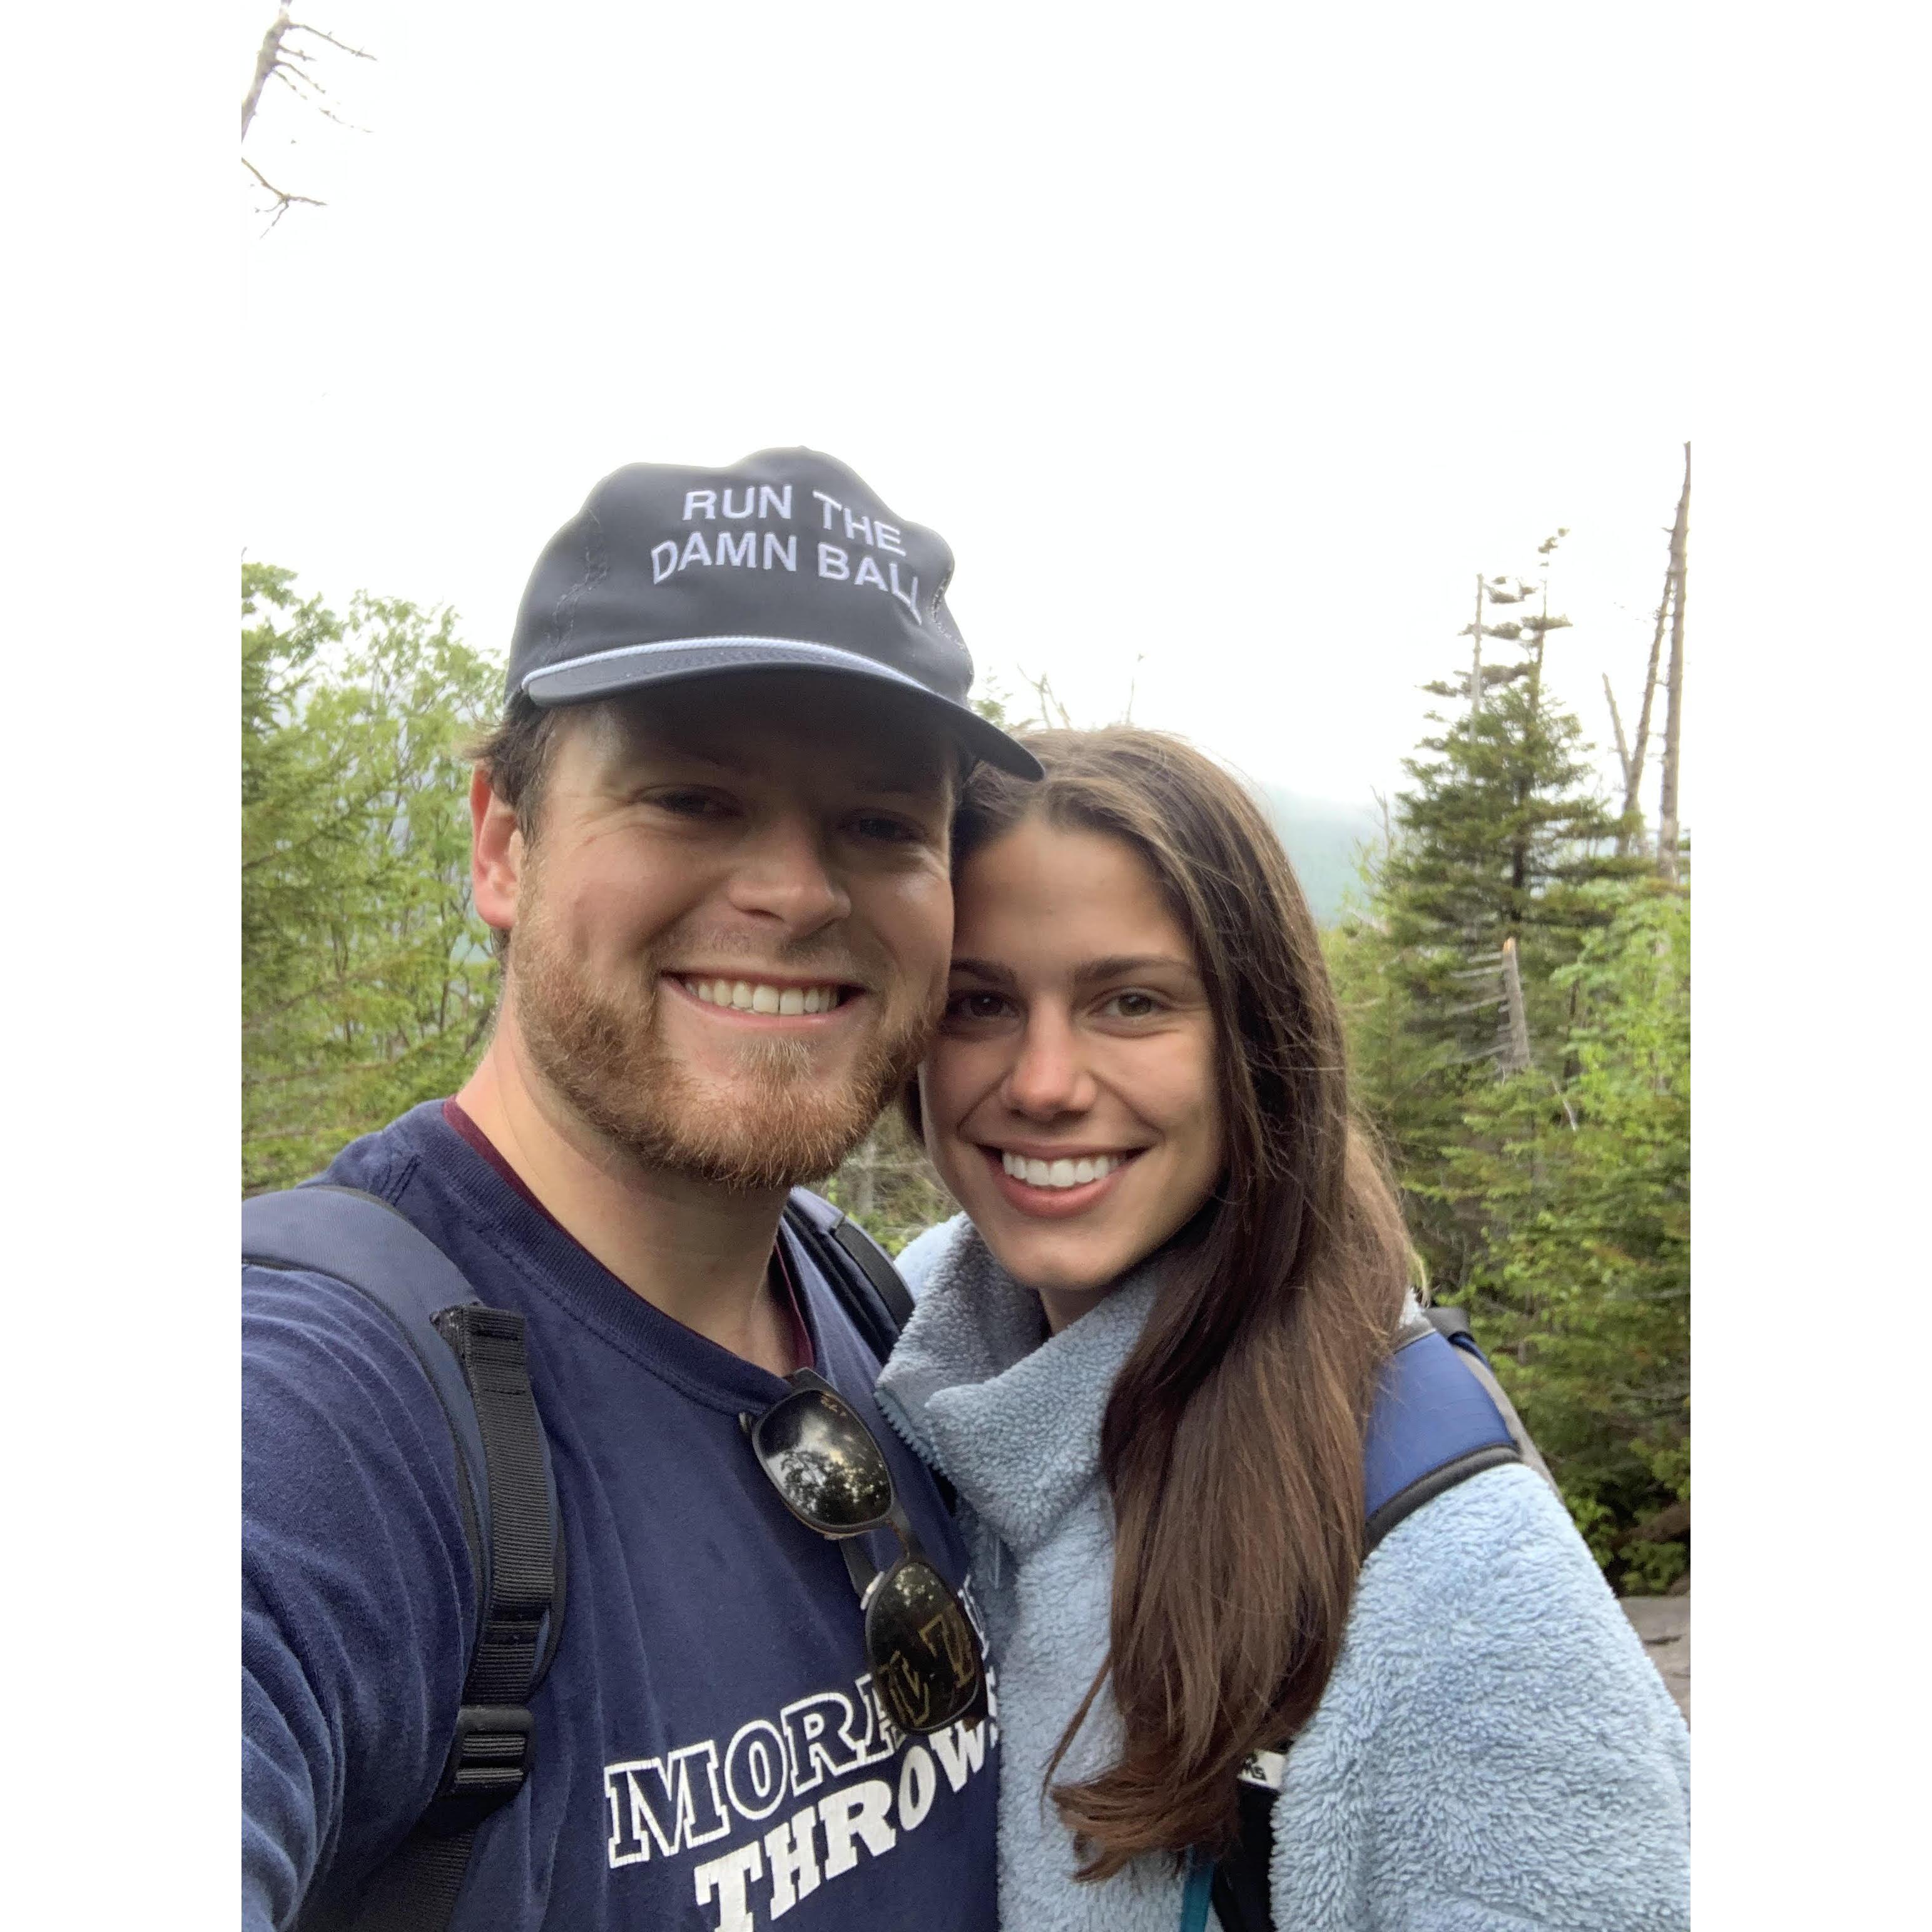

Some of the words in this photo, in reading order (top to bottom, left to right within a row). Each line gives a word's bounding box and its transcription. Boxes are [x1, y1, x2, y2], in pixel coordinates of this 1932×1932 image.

[682, 484, 793, 521] RUN
[813, 490, 907, 556] THE
[651, 531, 797, 586] DAMN
[817, 542, 922, 626] BALL
